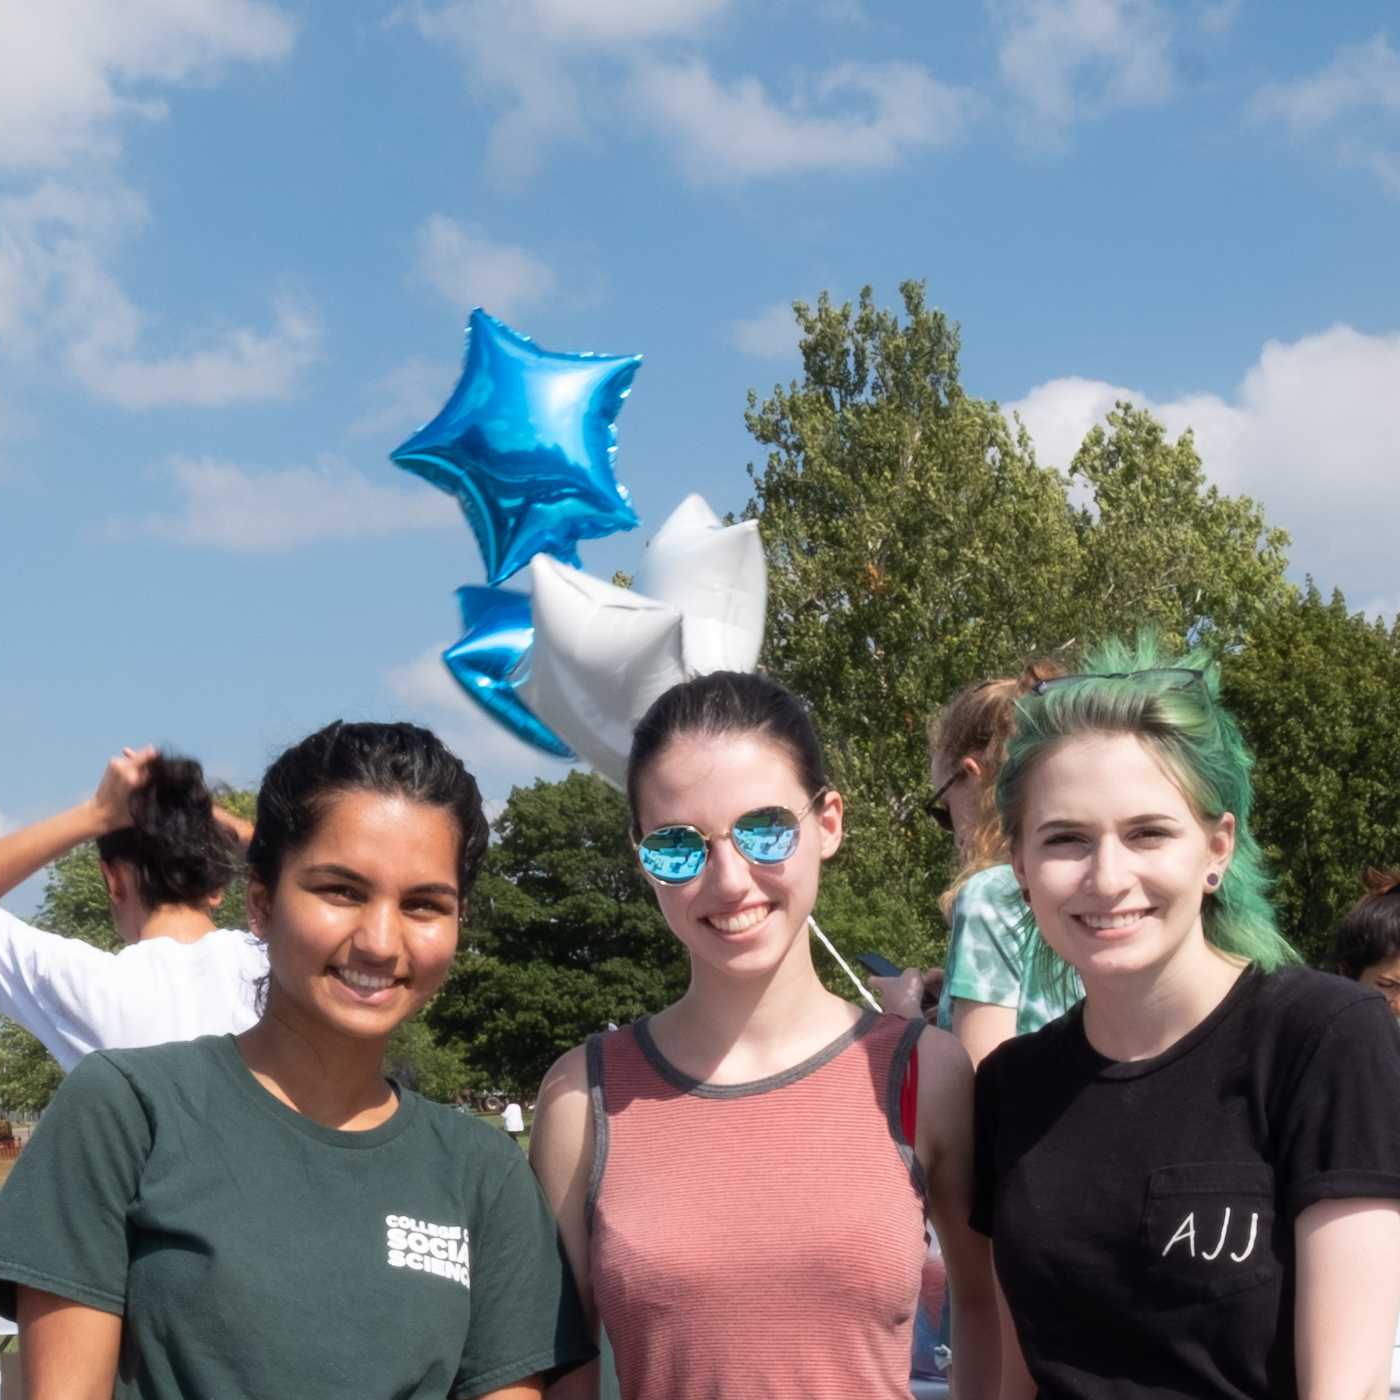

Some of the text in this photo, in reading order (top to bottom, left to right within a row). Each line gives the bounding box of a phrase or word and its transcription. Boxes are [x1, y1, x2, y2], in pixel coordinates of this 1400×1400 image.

[385, 1214, 462, 1240] COLLEGE
[1161, 1206, 1259, 1263] AJJ
[386, 1228, 470, 1272] SOCIA
[387, 1249, 471, 1291] SCIENC
